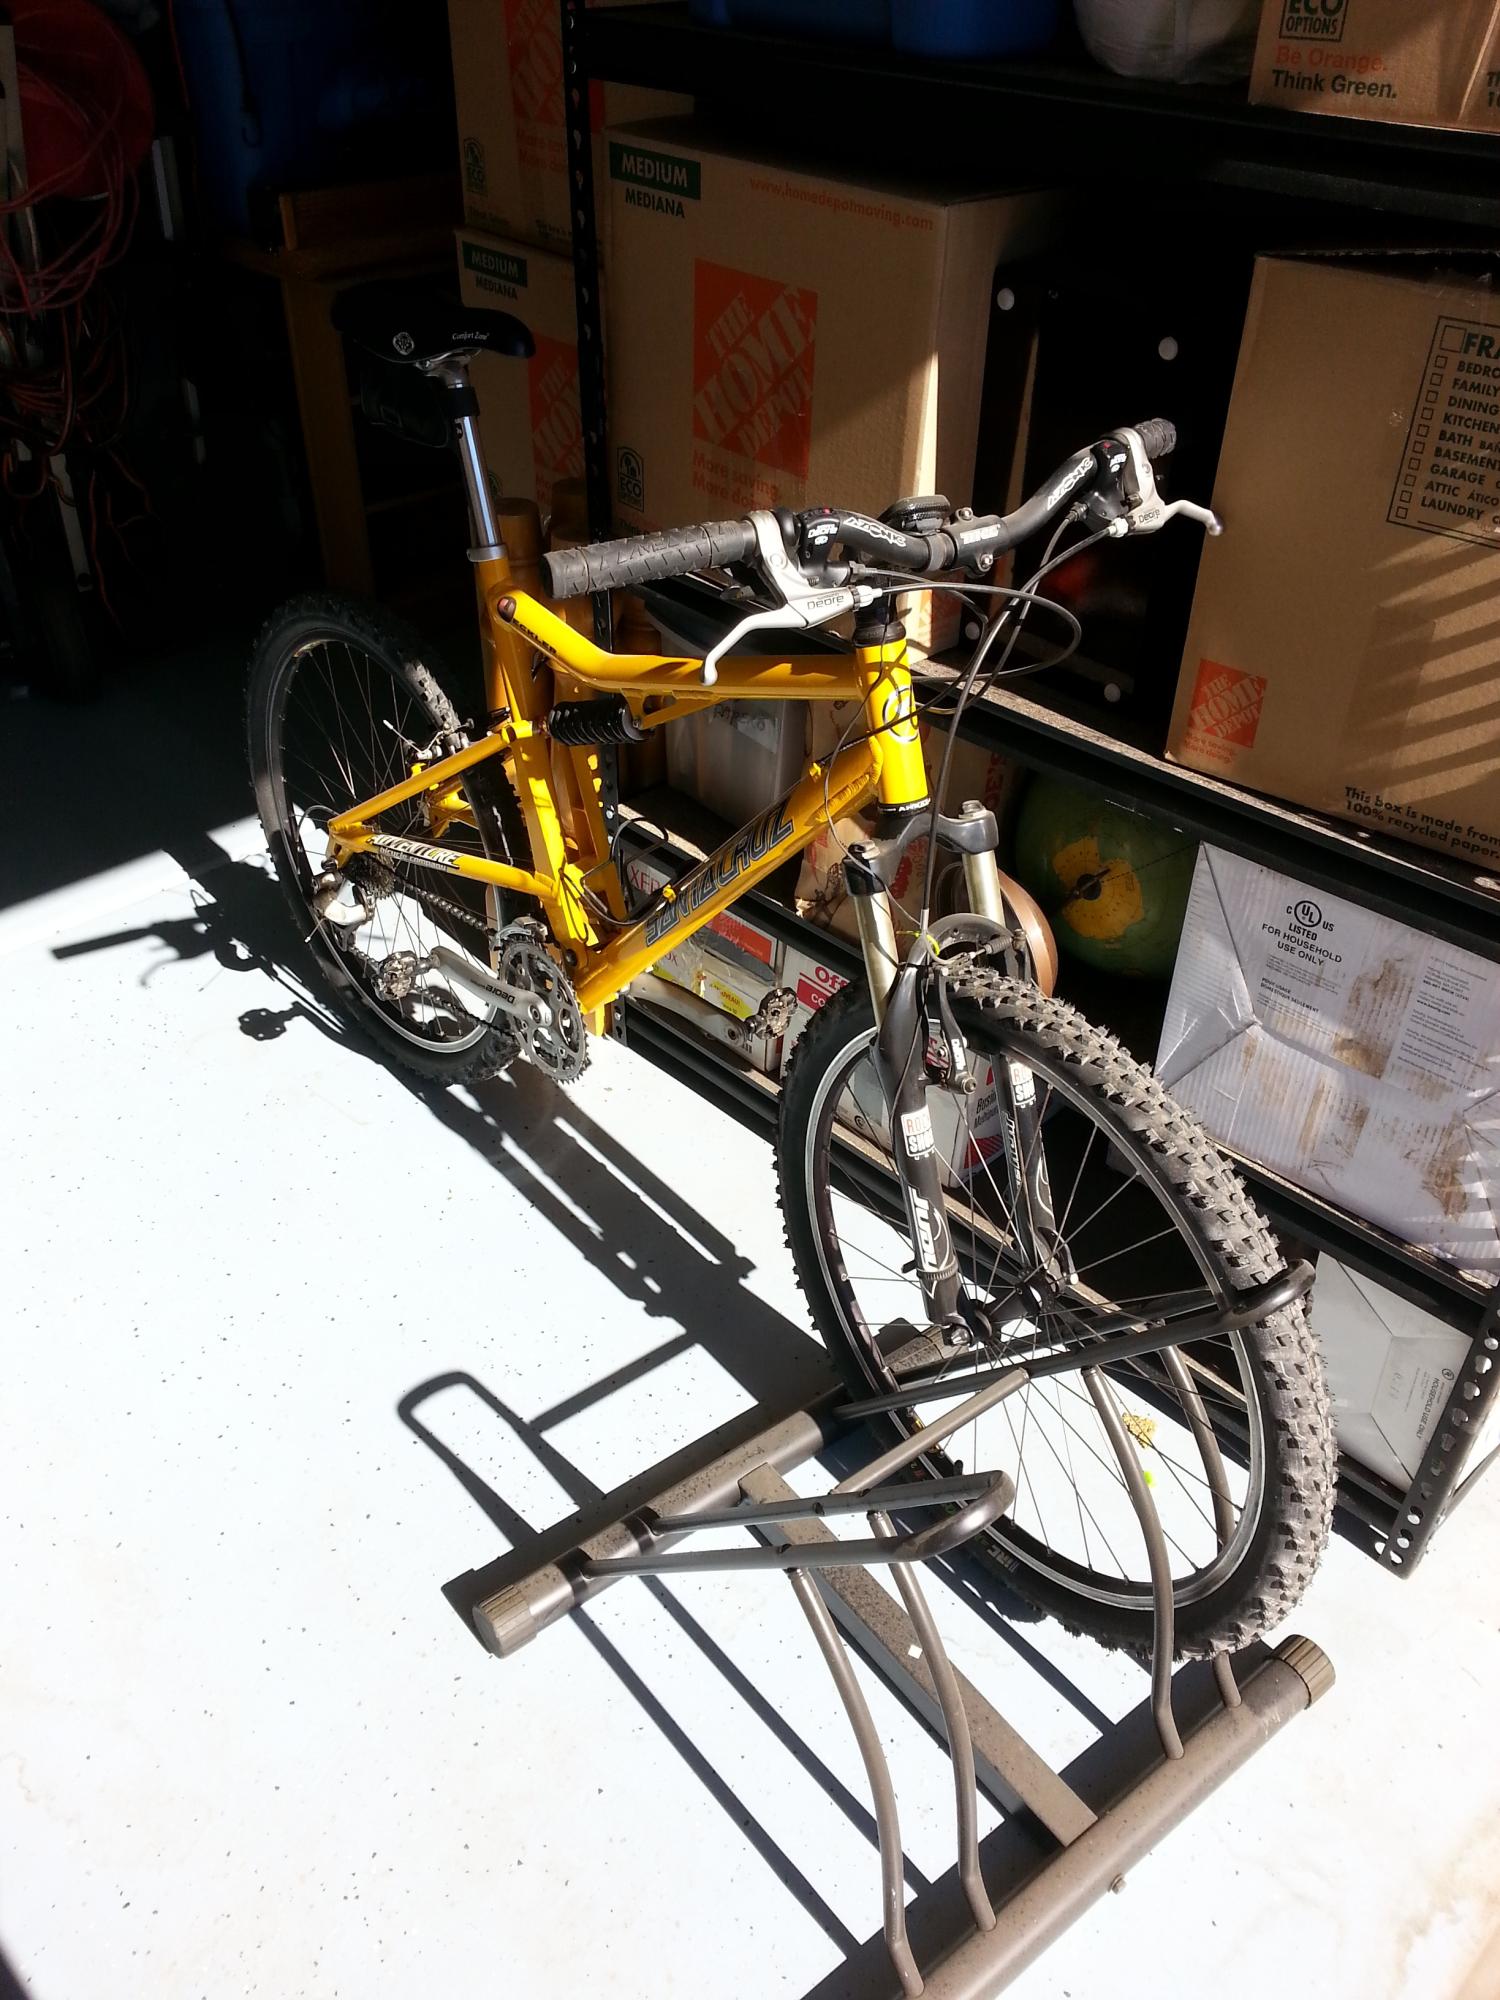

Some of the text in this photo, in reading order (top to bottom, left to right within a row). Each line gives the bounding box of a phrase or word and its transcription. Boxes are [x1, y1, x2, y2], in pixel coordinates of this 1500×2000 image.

[1286, 15, 1338, 35] OPTIONS
[1275, 45, 1388, 74] Be Orange.
[1272, 69, 1398, 99] Think Green.
[621, 152, 689, 188] MEDIUM
[625, 187, 686, 219] MEDIANA
[749, 176, 934, 231] www.homedepotmoving.com
[471, 250, 519, 278] MEDIUM
[475, 273, 518, 300] MEDIANA
[704, 290, 757, 359] THE
[693, 282, 817, 448] HOME
[1452, 377, 1500, 397] FAMILY
[1448, 396, 1500, 416] DINING
[1443, 412, 1500, 434] KITCHEN
[1438, 430, 1473, 447] BATH
[693, 449, 730, 479] More
[1430, 463, 1486, 486] GARAGE
[693, 471, 729, 501] More
[1425, 480, 1460, 497] ATTIC
[1138, 508, 1161, 524] Deore
[1420, 496, 1485, 521] LAUNDRY
[807, 594, 844, 611] Deore
[1345, 786, 1371, 804] This
[1375, 795, 1402, 815] box
[1406, 807, 1417, 819] is
[1421, 814, 1463, 834] made
[1346, 801, 1500, 859] 100% recycled paper.
[1288, 922, 1318, 941] LISTED
[1322, 920, 1335, 932] US
[1262, 923, 1343, 963] FOR HOUSEHOLD
[1277, 941, 1325, 967] USE ONLY
[485, 984, 516, 1004] Deore
